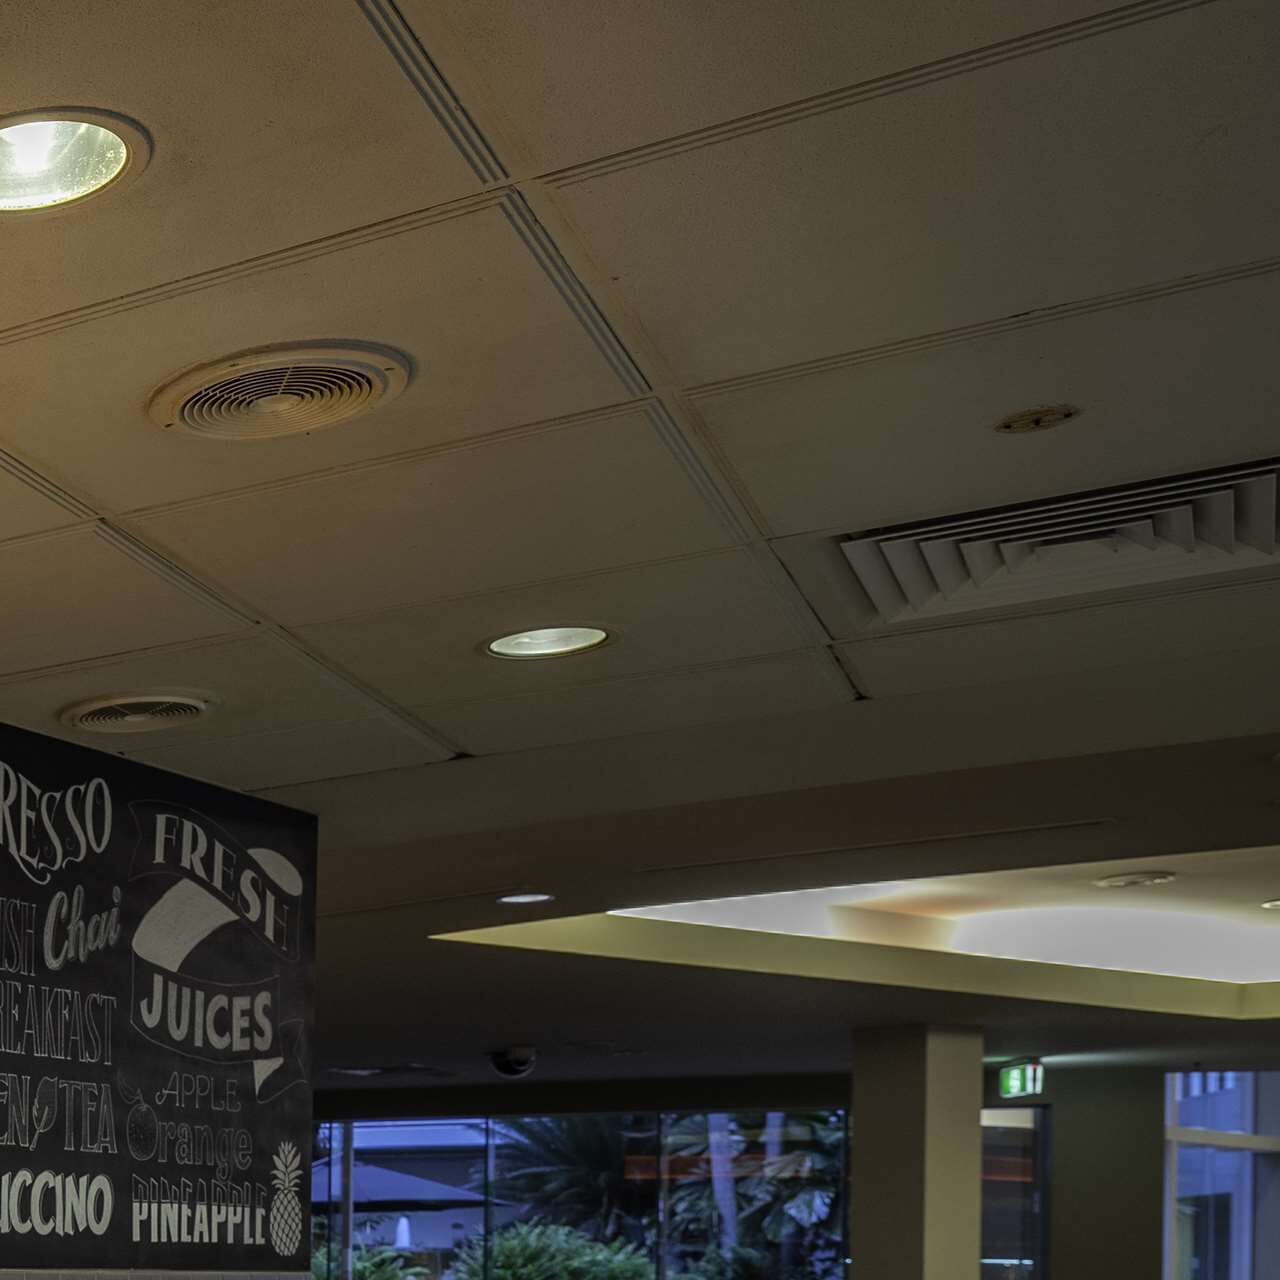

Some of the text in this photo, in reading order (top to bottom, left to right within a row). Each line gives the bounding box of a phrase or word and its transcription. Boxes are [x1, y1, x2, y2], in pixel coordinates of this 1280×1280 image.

[151, 813, 290, 951] FRESH
[43, 884, 121, 971] Chai
[141, 971, 274, 1055] JUICES
[58, 1078, 119, 1154] TEA
[154, 1071, 242, 1113] APPLE
[131, 1172, 268, 1246] PINEAPPLE
